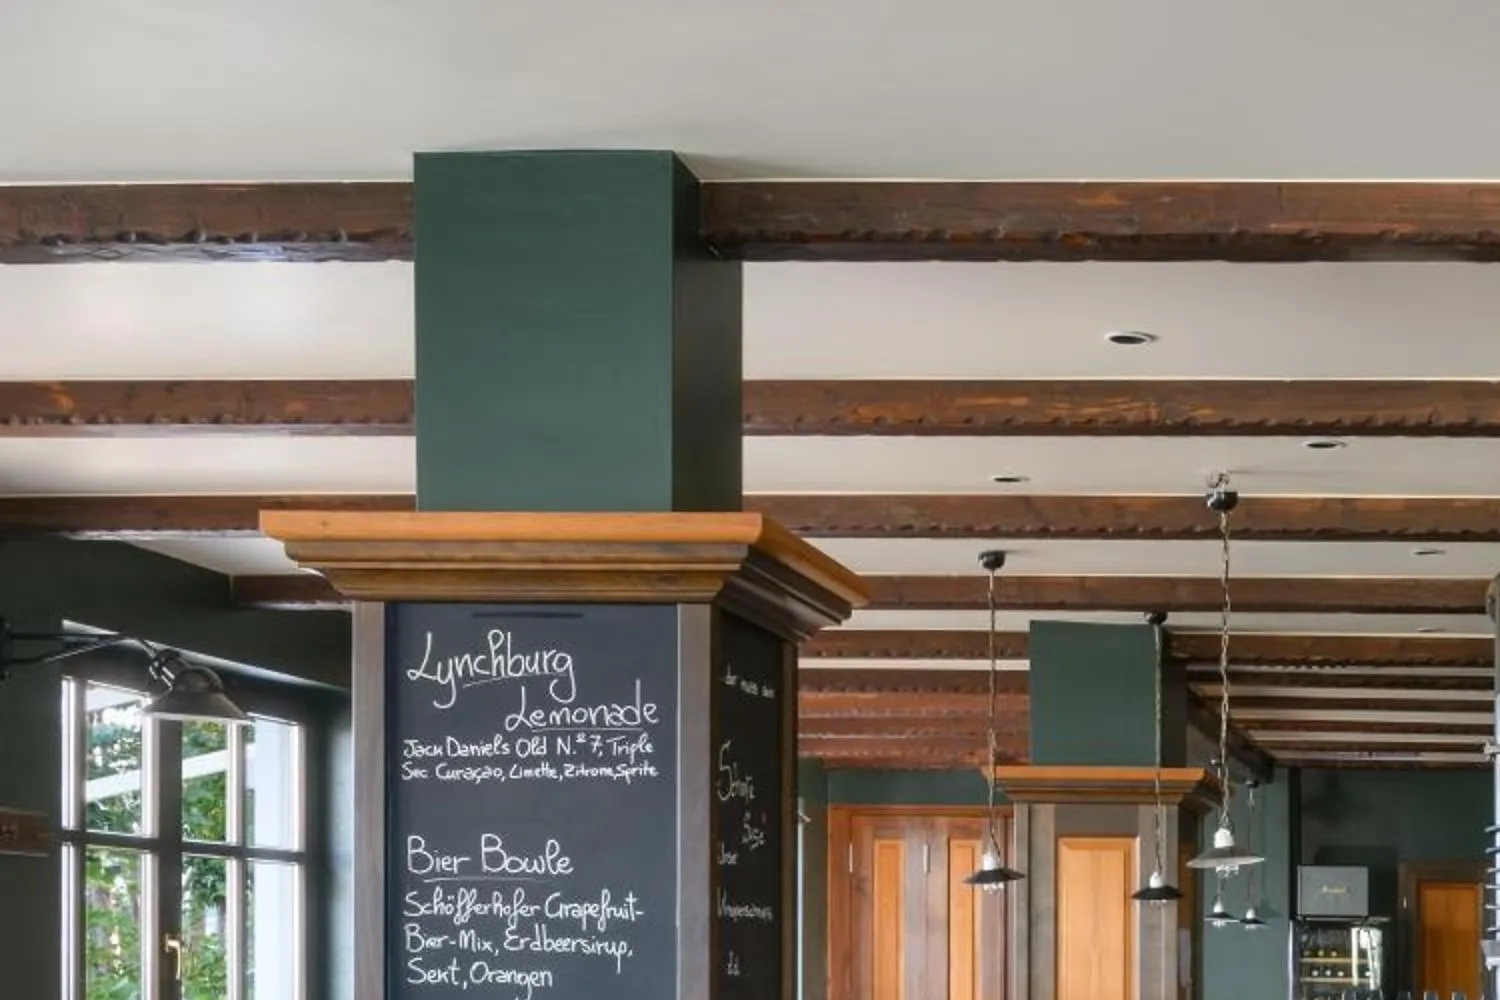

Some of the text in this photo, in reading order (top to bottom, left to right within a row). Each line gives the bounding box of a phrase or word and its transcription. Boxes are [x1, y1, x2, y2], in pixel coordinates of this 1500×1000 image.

[406, 629, 576, 709] Lynchburg
[504, 678, 659, 731] Lemonade
[446, 735, 510, 757] Daniels
[515, 735, 547, 759] Old
[605, 731, 654, 765] Triple
[401, 761, 428, 780] Sec
[406, 832, 575, 876] Bier Bowle
[403, 886, 541, 929] Schöfferhofer
